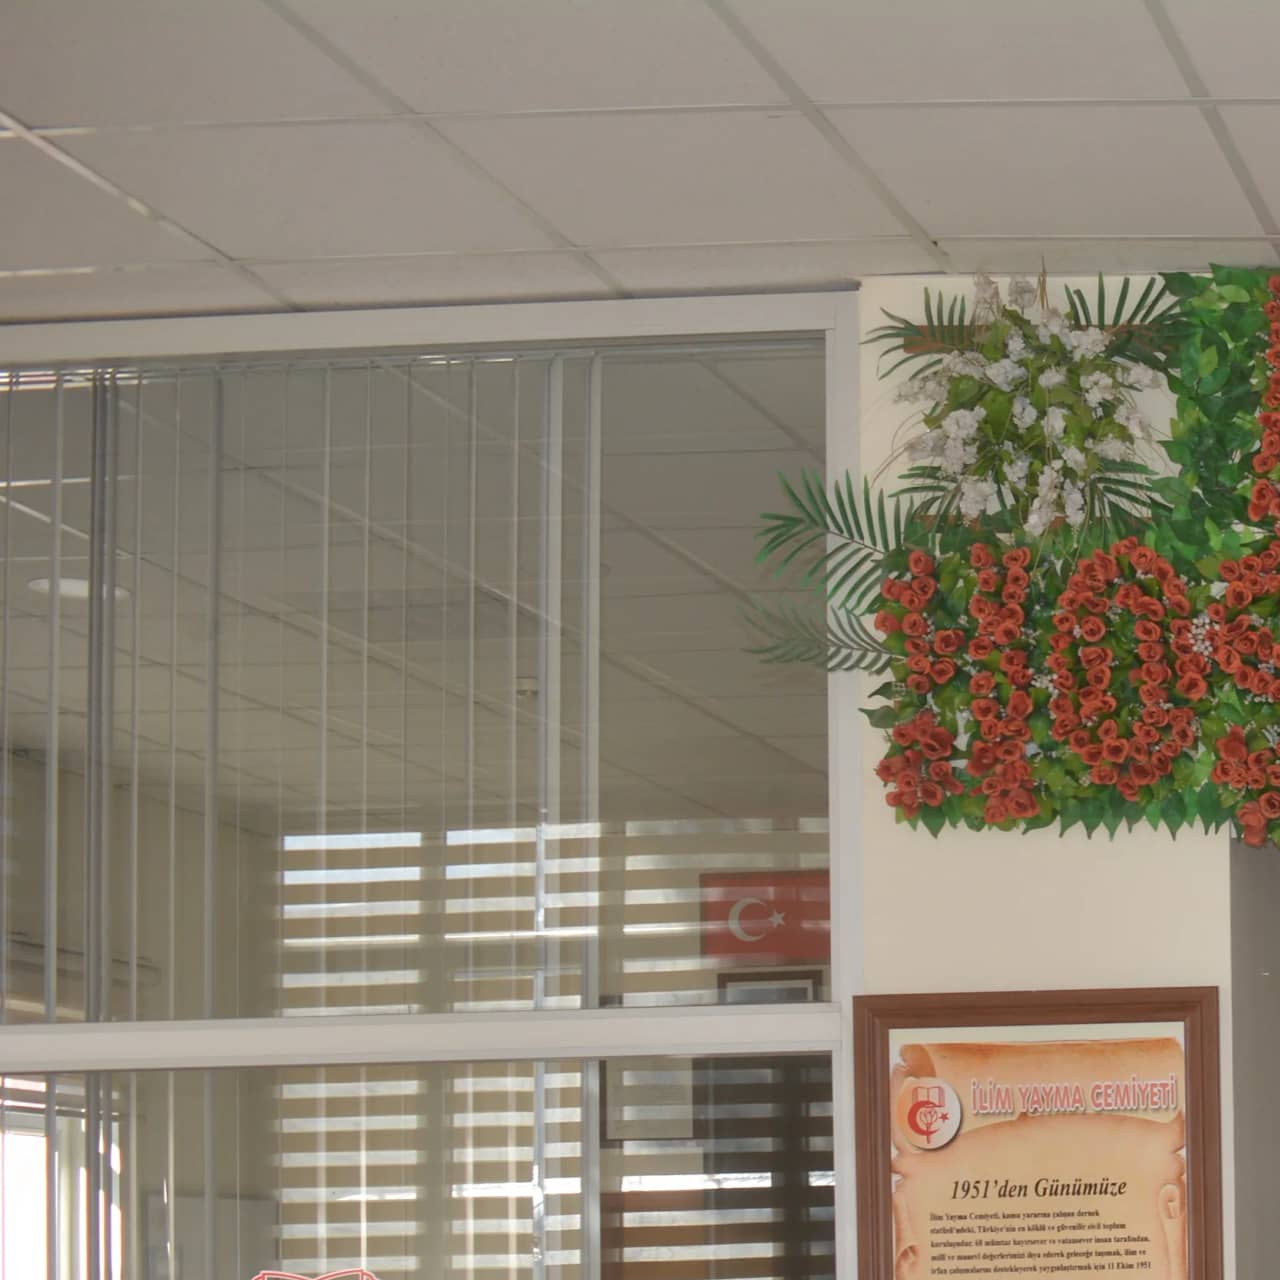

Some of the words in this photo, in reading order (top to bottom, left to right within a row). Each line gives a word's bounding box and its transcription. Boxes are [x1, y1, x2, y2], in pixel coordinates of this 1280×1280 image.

[971, 1079, 1014, 1114] İLİM
[1018, 1083, 1085, 1113] YAYMA
[1091, 1073, 1178, 1110] CEMİYETİ
[952, 1180, 1028, 1199] 1951'den
[1034, 1178, 1127, 1197] Günümüze
